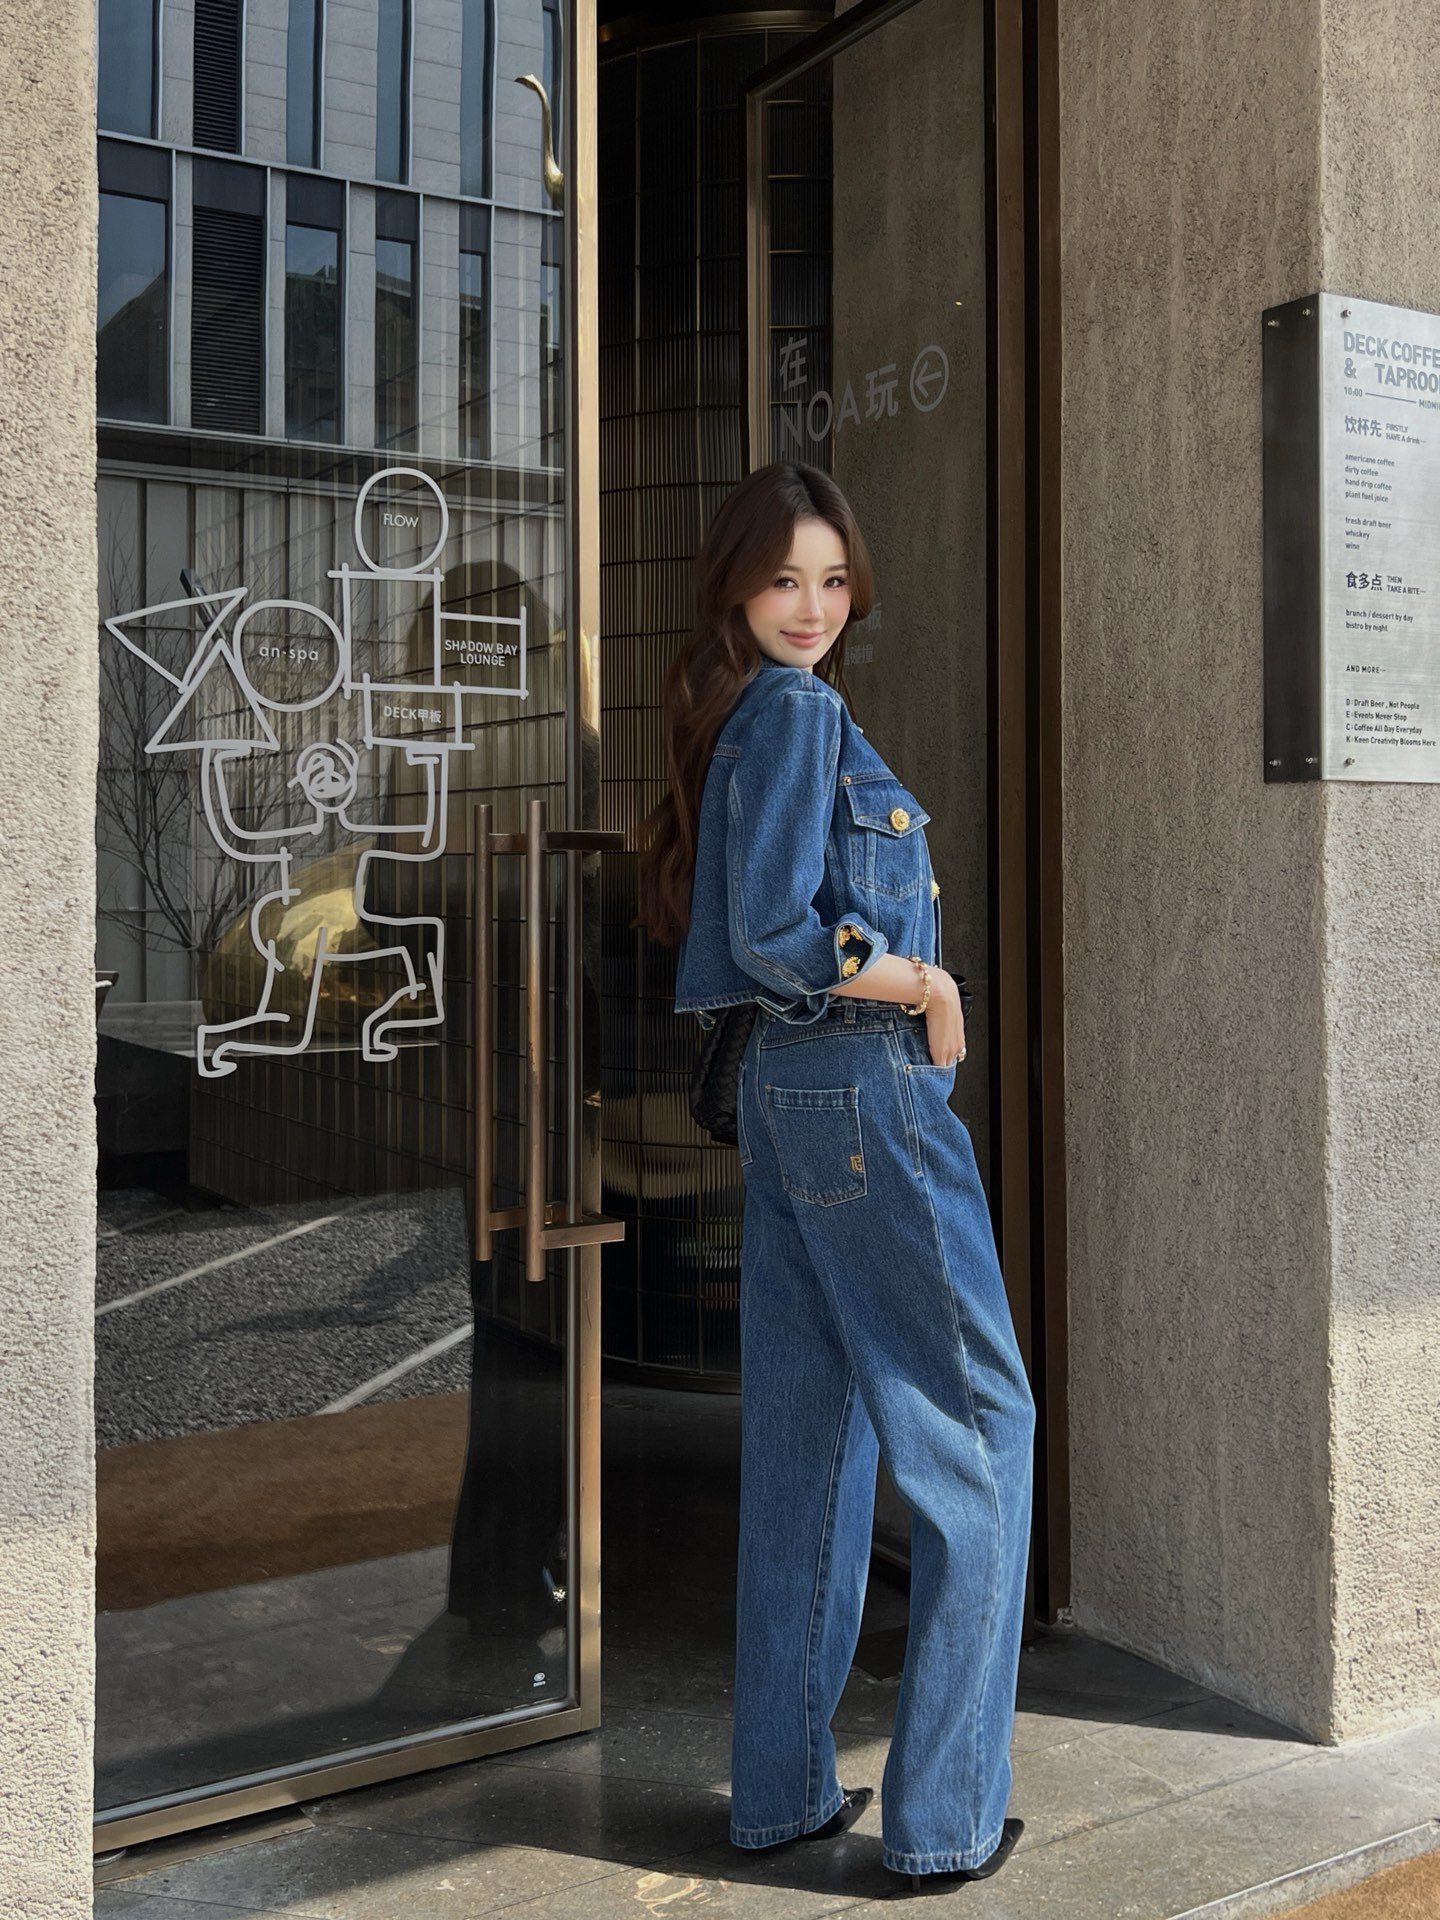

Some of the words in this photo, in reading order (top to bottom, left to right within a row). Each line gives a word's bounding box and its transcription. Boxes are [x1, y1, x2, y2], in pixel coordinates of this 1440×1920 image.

[1344, 331, 1389, 360] DECK
[780, 337, 807, 393] 在
[1344, 358, 1357, 380] &
[1374, 363, 1440, 394] TAPROO
[1344, 386, 1363, 397] 10:00
[1345, 416, 1382, 437] 饮杯先
[1386, 423, 1408, 433] FIRSTLY
[1386, 433, 1401, 441] HAVE
[1345, 454, 1376, 464] americano
[1377, 458, 1395, 467] coffee
[1345, 465, 1359, 475] dirty
[1360, 468, 1379, 476] coffee
[1345, 478, 1360, 486] hand
[1361, 480, 1373, 489] drip
[1374, 482, 1392, 491] coffee
[1345, 491, 1360, 499] plant
[1374, 493, 1389, 502] juice
[383, 513, 419, 528] FLOW
[1345, 516, 1361, 525] fresh
[1362, 518, 1377, 527] draft
[1378, 520, 1392, 528] beer
[1345, 529, 1370, 540] whiskey
[1345, 541, 1360, 550] wine
[1346, 571, 1383, 591] 食多点
[1387, 575, 1402, 584] THEN
[1387, 585, 1402, 594] TAKE
[1346, 609, 1367, 618] brunch
[1372, 611, 1394, 620] dessert
[1395, 613, 1402, 622] by
[1403, 614, 1413, 623] day
[1346, 621, 1363, 630] bistro
[1364, 622, 1372, 631] by
[1372, 624, 1388, 632] night
[445, 640, 494, 653] SHADOW
[496, 643, 518, 656] BAY
[460, 653, 506, 667] LOUNGE
[1346, 664, 1360, 672] AND
[1354, 699, 1369, 707] Draft
[1389, 701, 1399, 709] Not
[1400, 701, 1420, 710] People
[1354, 711, 1374, 719] Events
[1375, 712, 1392, 720] Never
[1394, 713, 1407, 722] Stop
[1354, 723, 1373, 732] Coffee
[1384, 725, 1395, 734] Day
[1396, 725, 1422, 735] Everyday
[1354, 736, 1369, 744] Keen
[1370, 736, 1399, 746] Creativity
[1400, 738, 1421, 746] Blooms
